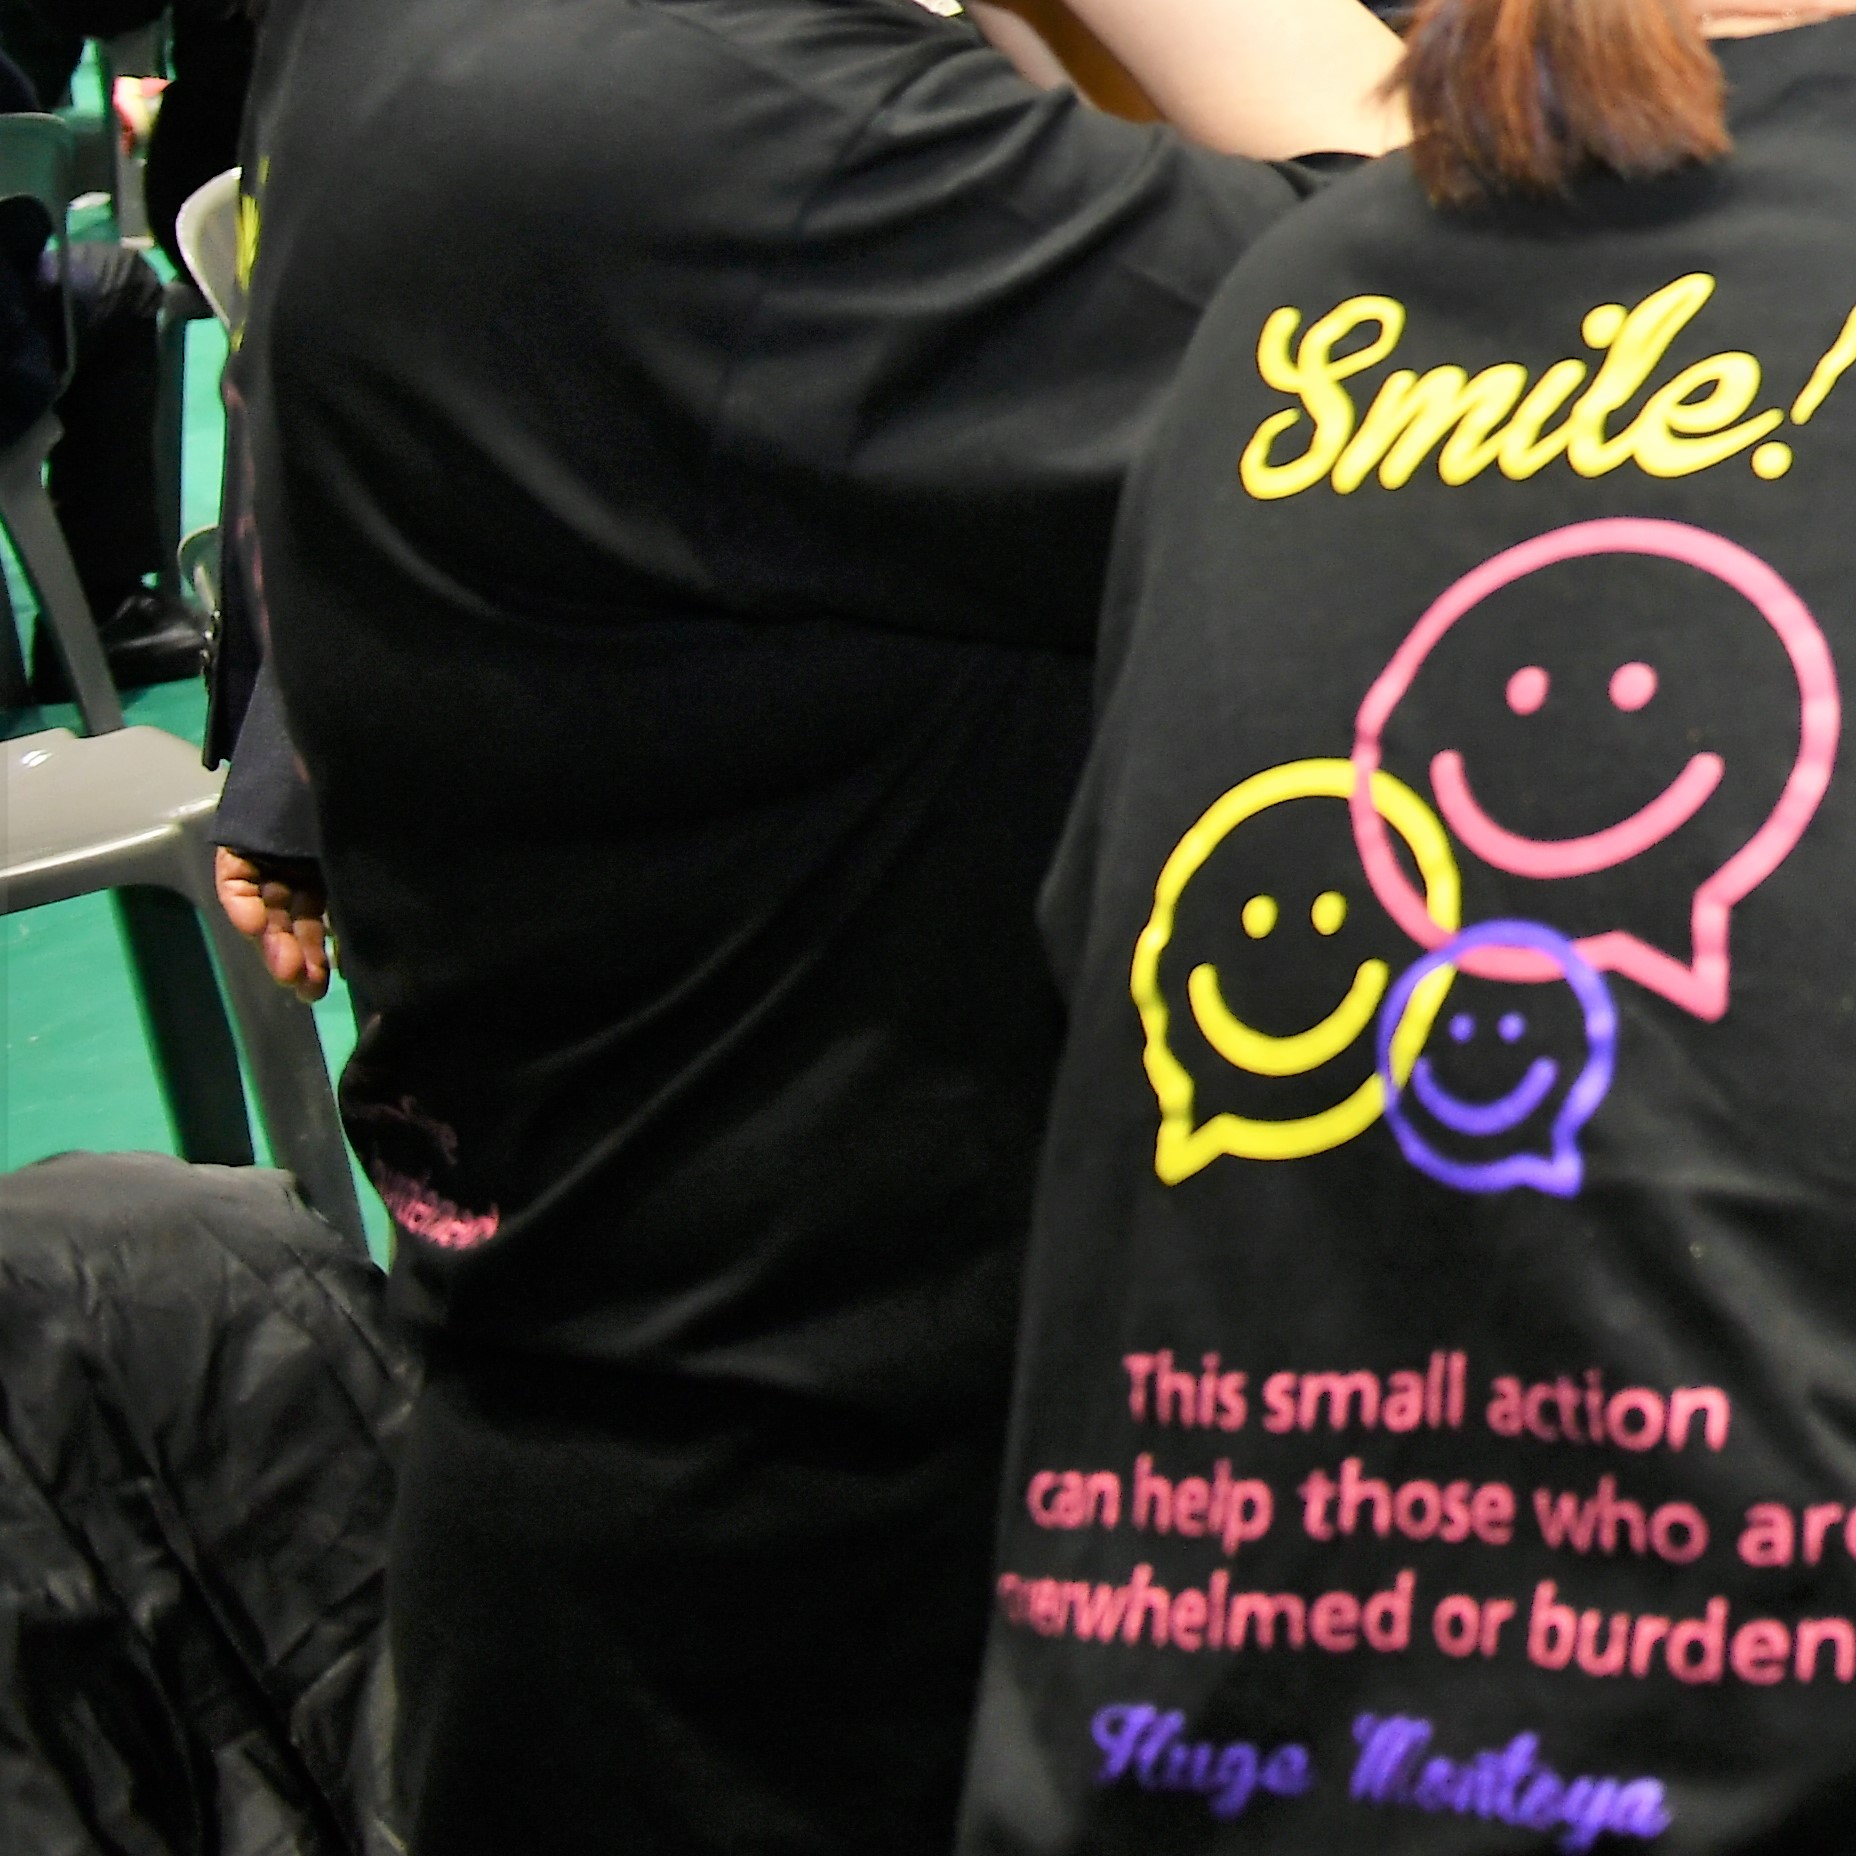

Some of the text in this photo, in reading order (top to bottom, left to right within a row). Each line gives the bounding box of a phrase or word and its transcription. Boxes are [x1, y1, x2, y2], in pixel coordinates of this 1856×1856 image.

[1122, 1348, 1733, 1452] This small action
[1026, 1469, 1122, 1530] can
[1132, 1452, 1275, 1556] help
[1300, 1456, 1517, 1546] those
[1533, 1476, 1709, 1562] who
[1433, 1593, 1517, 1657] or
